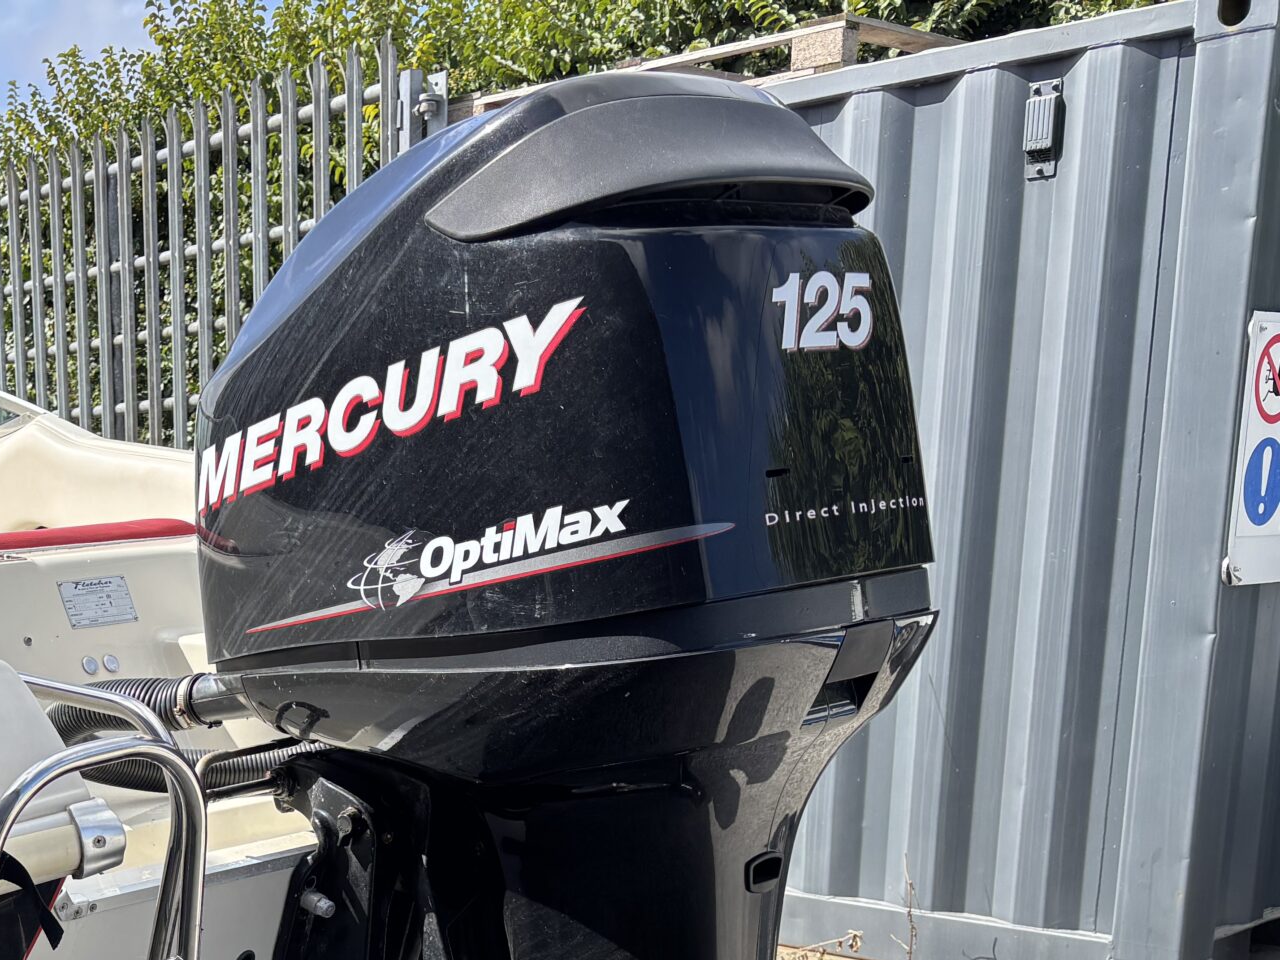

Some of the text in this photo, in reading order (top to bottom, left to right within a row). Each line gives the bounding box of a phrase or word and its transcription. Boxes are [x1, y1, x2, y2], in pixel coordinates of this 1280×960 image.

[772, 271, 873, 352] 125
[199, 296, 587, 516] MERCURY
[420, 499, 630, 583] OptiMax
[765, 496, 925, 526] Direct Injection
